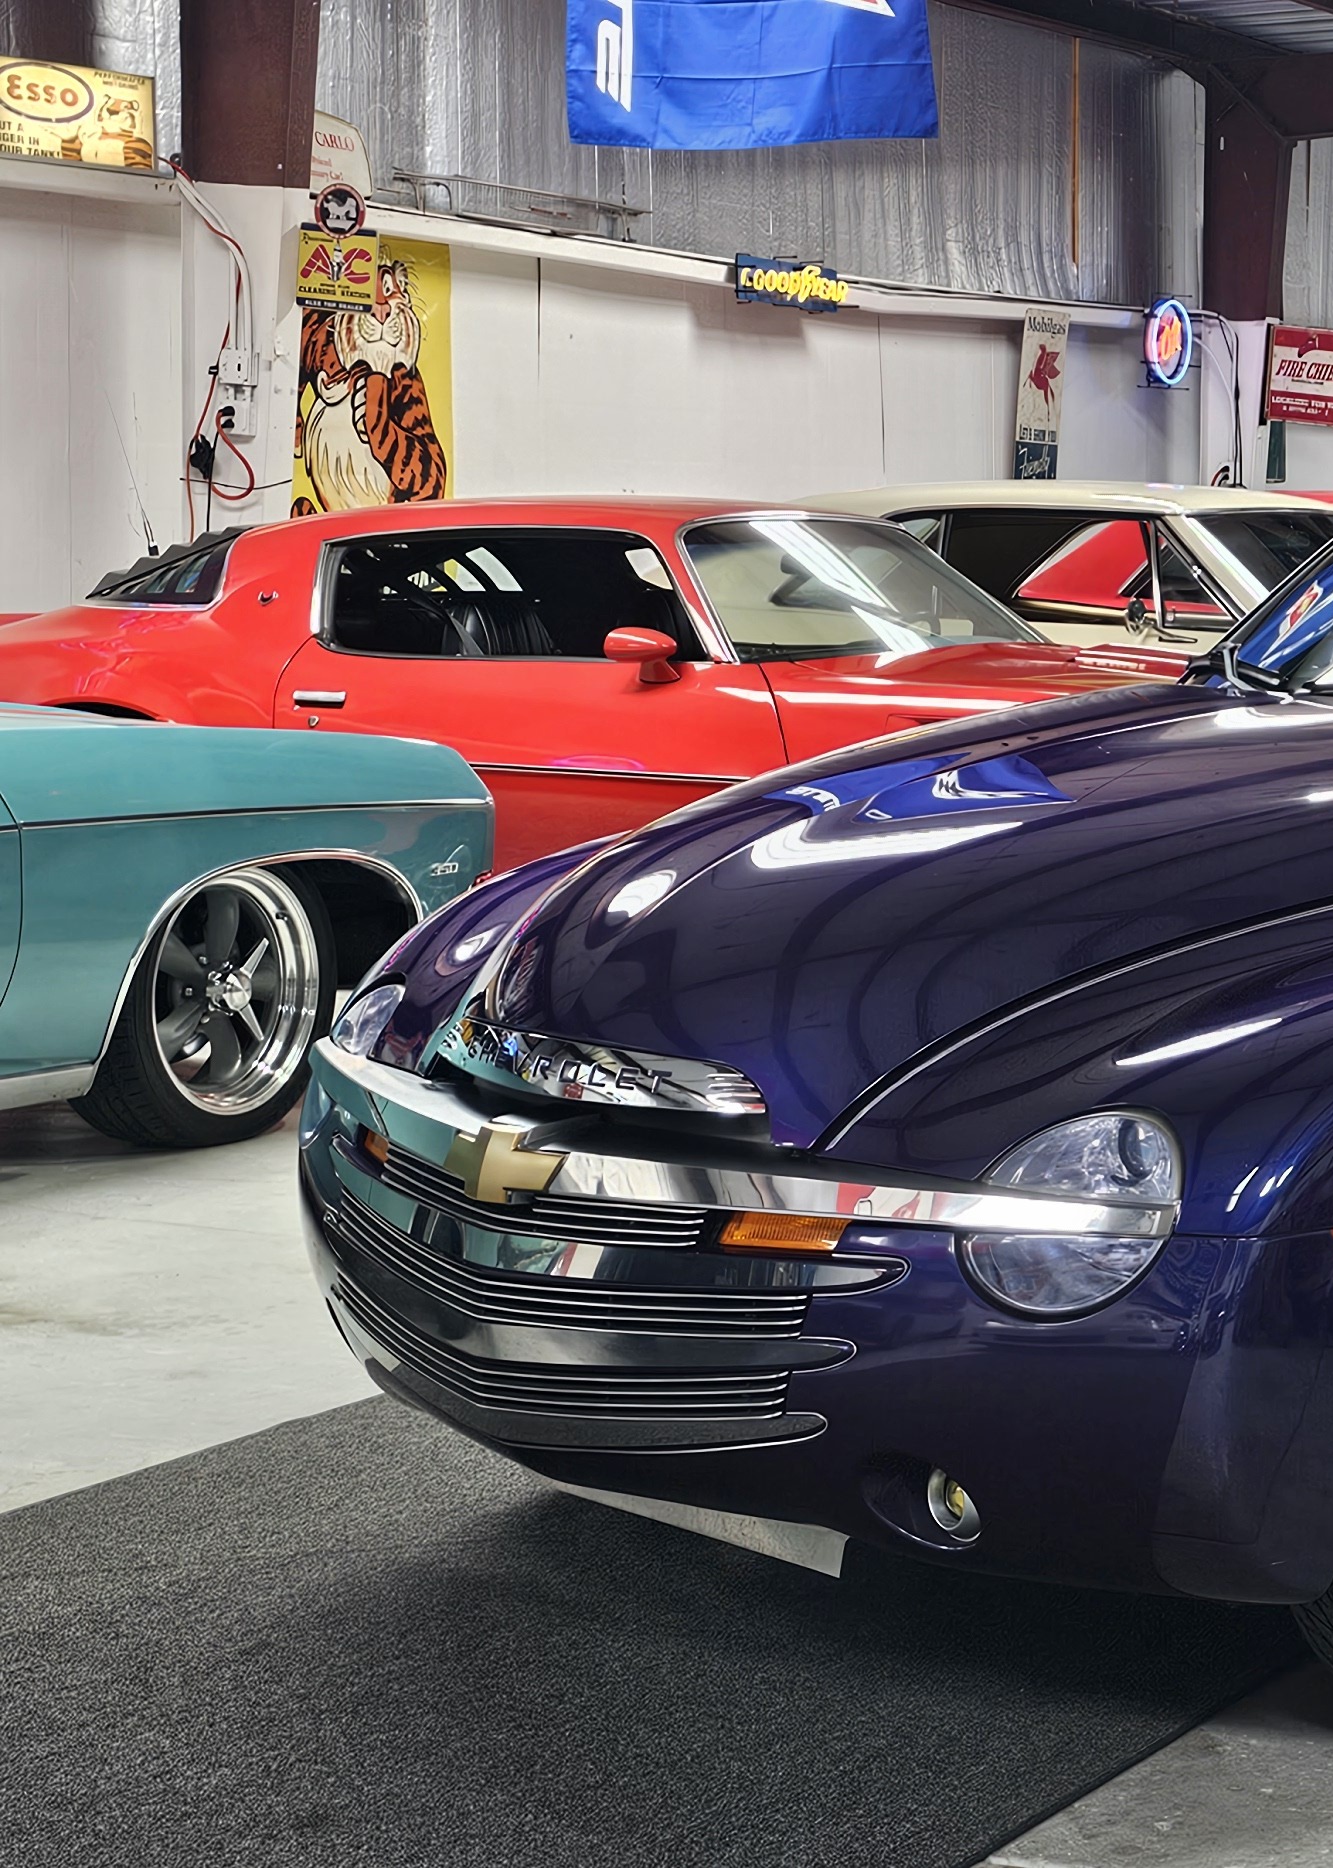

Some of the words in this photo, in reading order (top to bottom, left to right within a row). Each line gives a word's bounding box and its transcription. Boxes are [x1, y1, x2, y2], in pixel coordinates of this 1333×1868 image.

[7, 74, 79, 107] ESSO
[0, 120, 12, 131] UT
[314, 131, 355, 152] CARLO
[1275, 359, 1308, 378] FIRE
